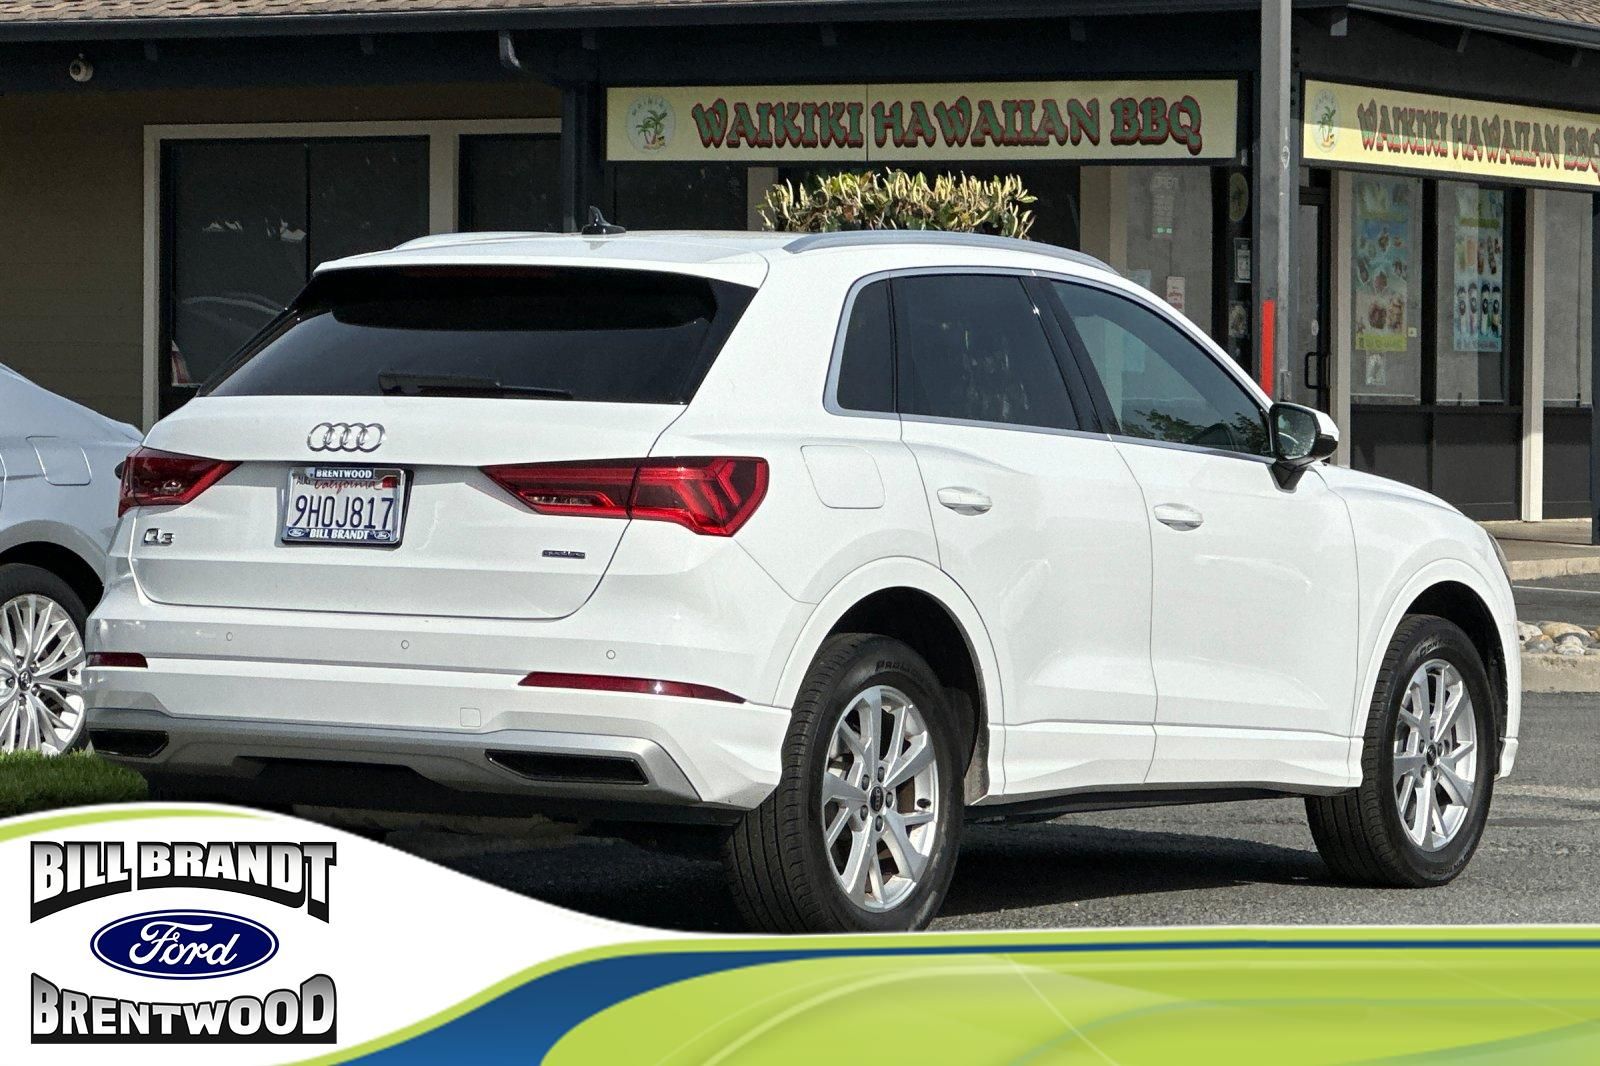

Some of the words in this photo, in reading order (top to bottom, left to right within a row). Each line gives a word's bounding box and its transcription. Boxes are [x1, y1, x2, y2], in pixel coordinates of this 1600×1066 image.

[691, 98, 864, 149] WAIKIKI
[871, 96, 1100, 148] HAWAIIAN
[1110, 95, 1202, 156] BBQ
[1357, 97, 1448, 157] WAIKIKI
[1451, 114, 1559, 169] HAWAIIAN
[316, 469, 372, 478] BRENTWOOD
[292, 495, 394, 529] 9HOJ817
[309, 529, 330, 539] BILL
[331, 529, 369, 540] BRANDT
